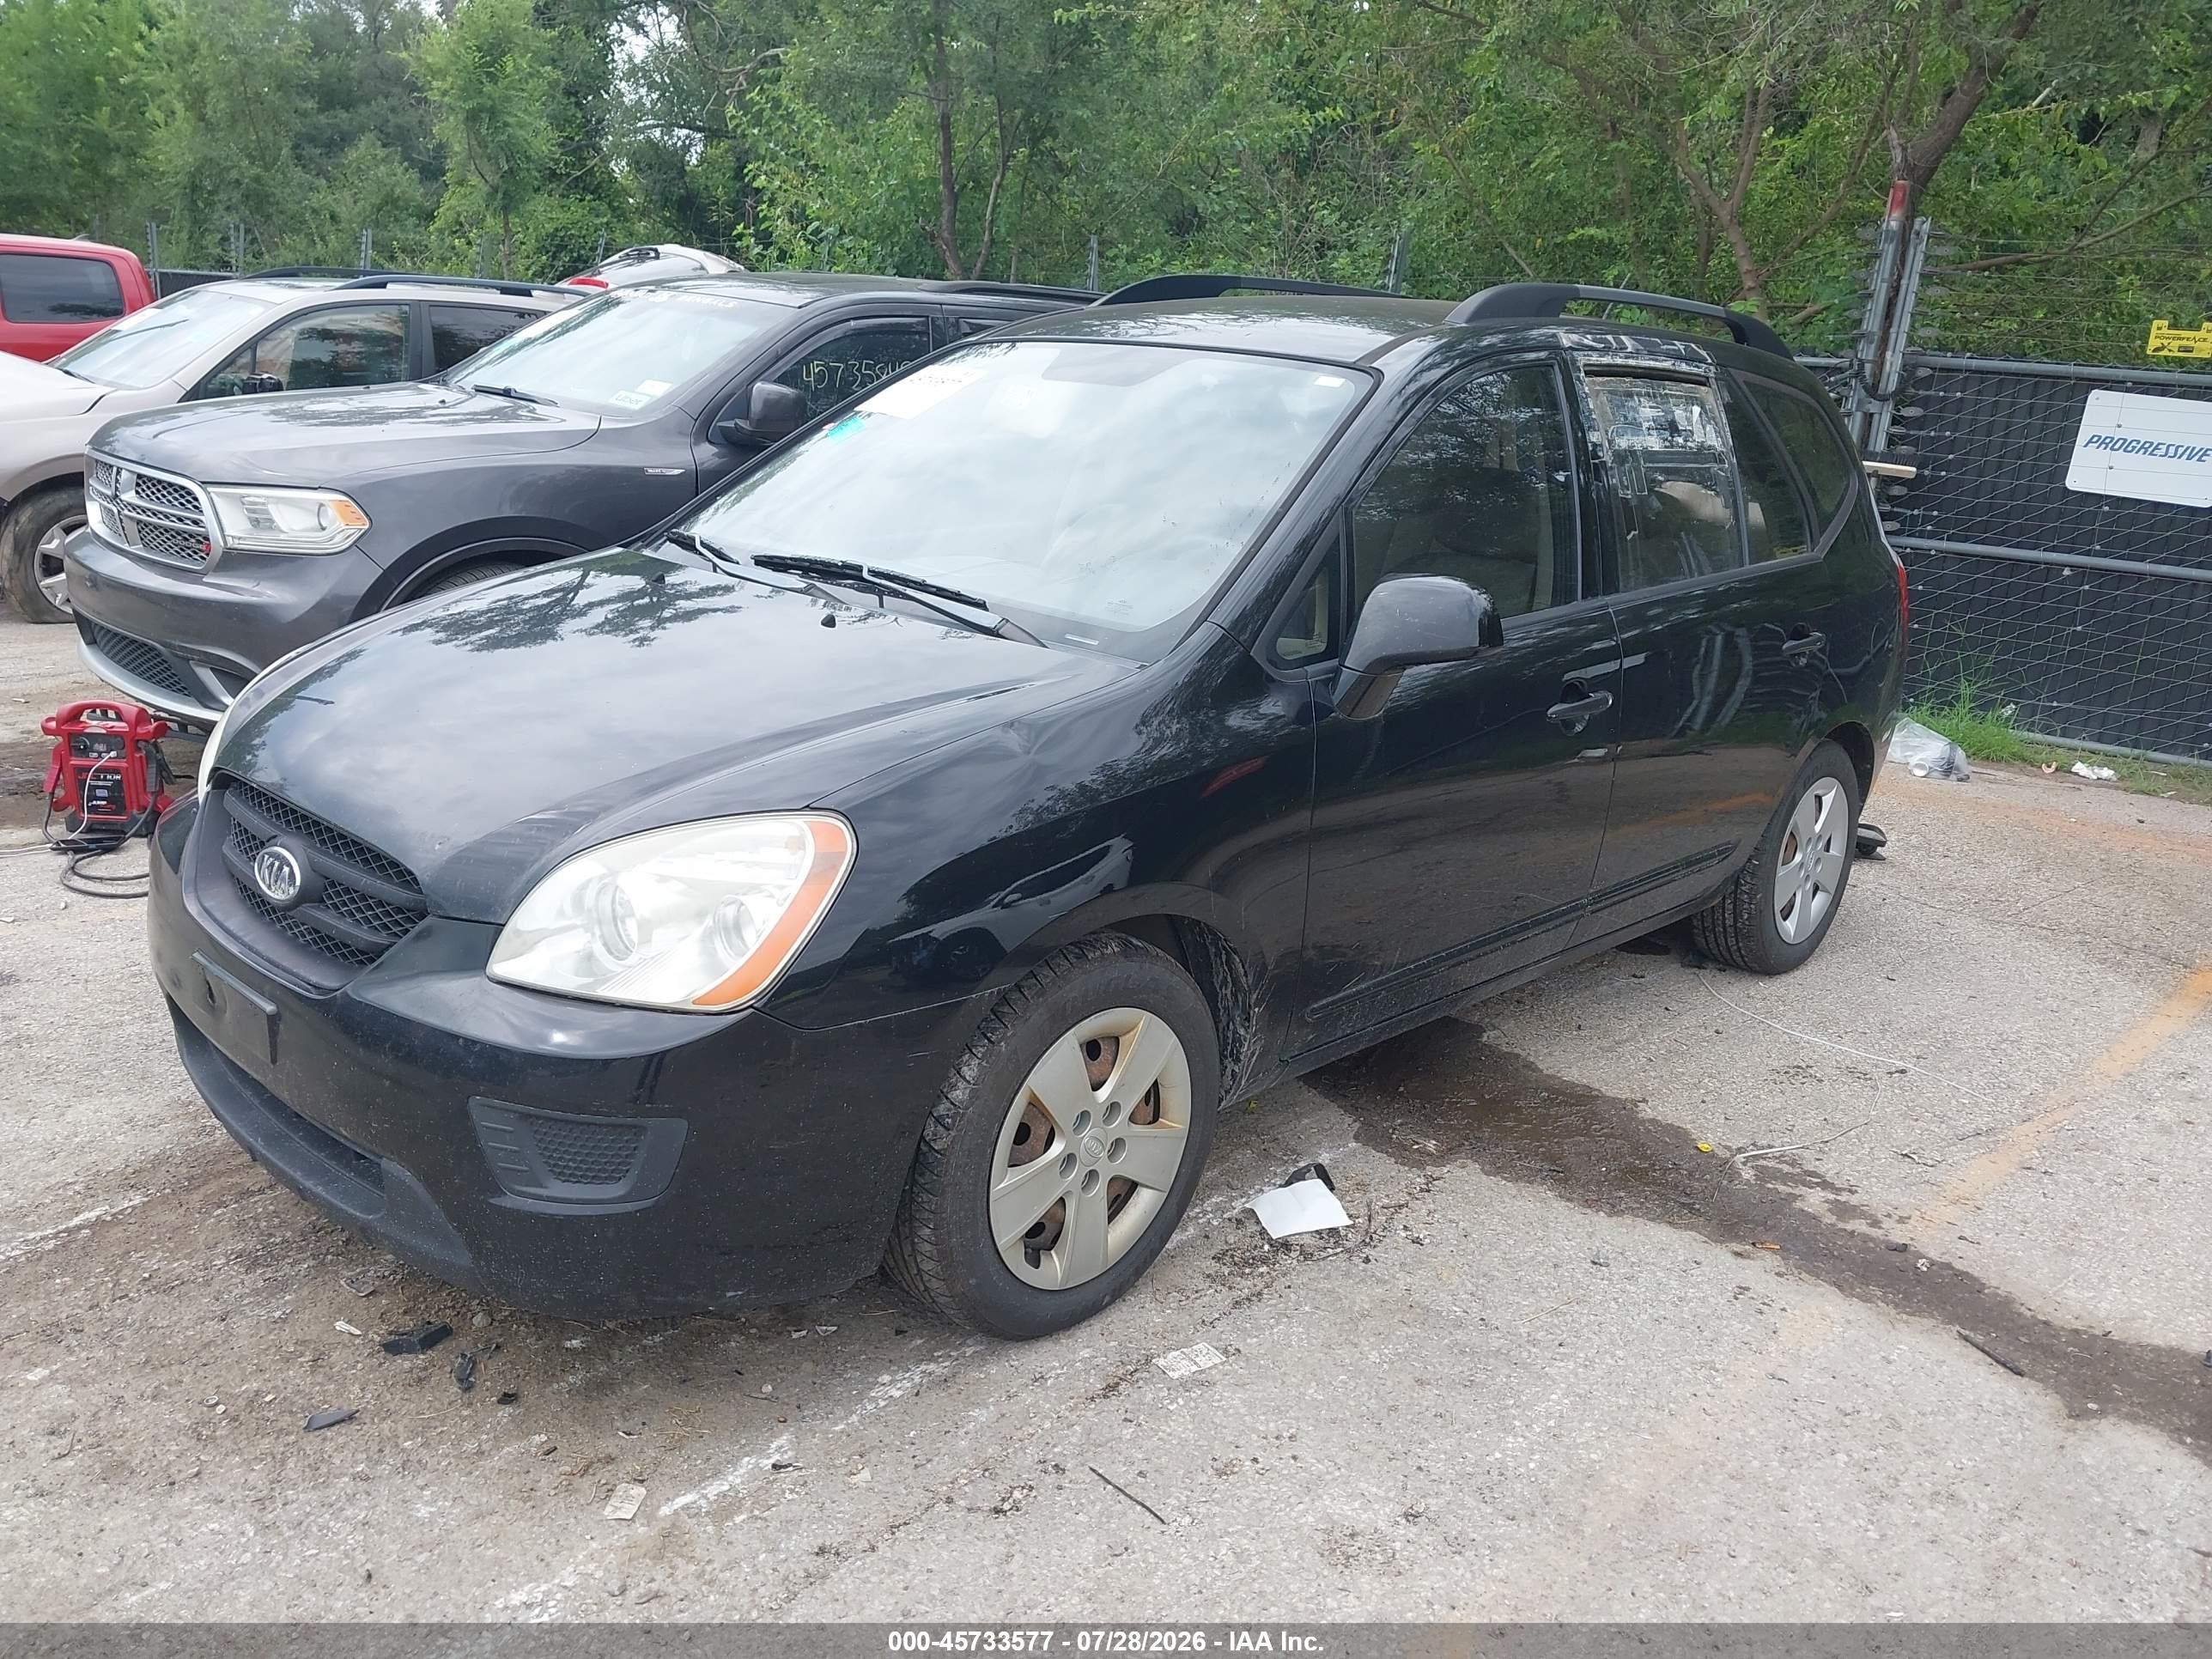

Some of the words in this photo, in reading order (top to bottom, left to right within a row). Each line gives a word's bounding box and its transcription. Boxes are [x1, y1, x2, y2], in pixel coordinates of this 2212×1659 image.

[803, 361, 911, 392] 4573584
[2083, 434, 2212, 463] PROGRESSIVE
[173, 538, 204, 550] DODGE
